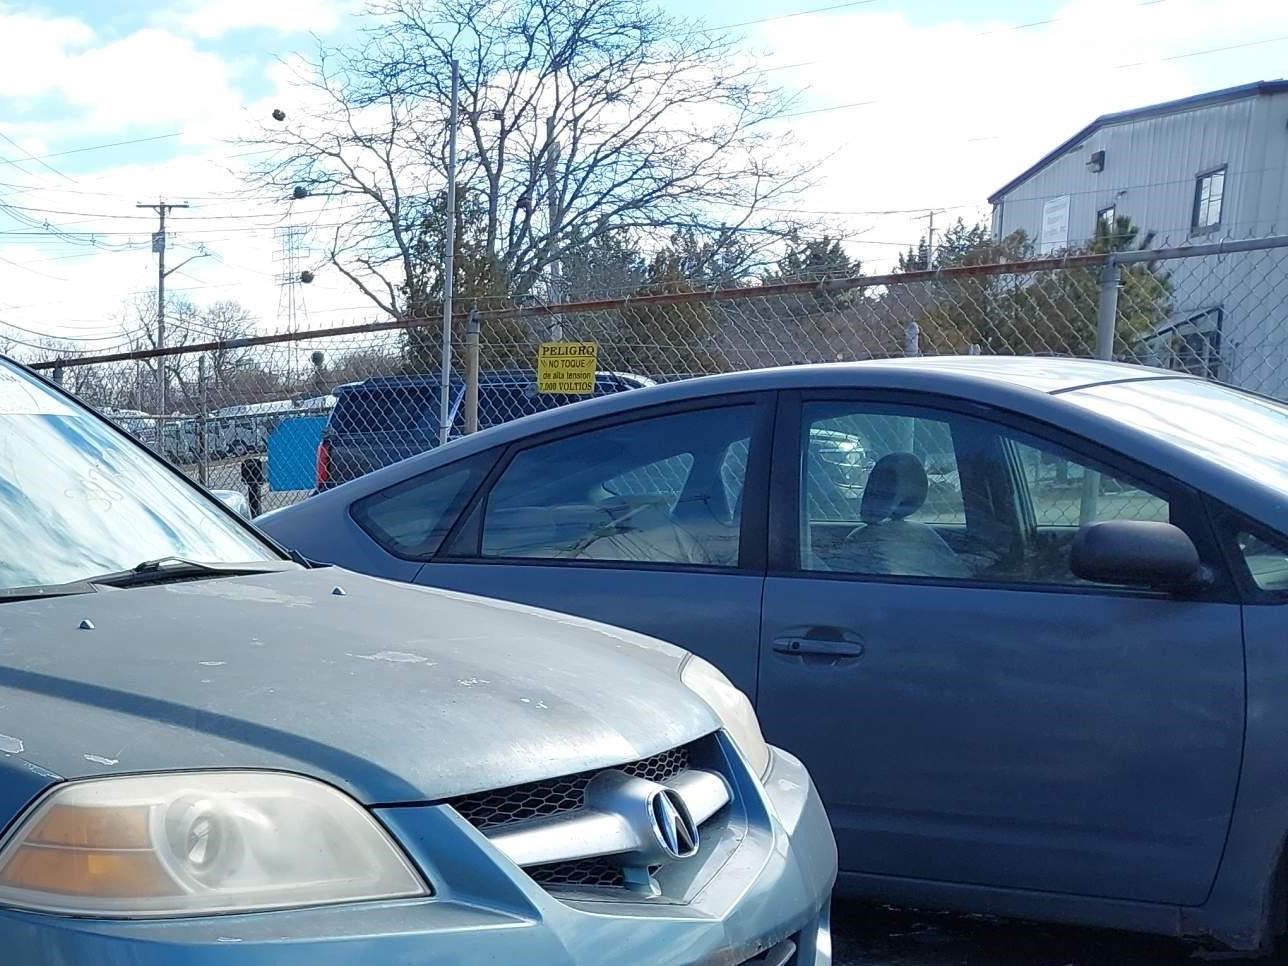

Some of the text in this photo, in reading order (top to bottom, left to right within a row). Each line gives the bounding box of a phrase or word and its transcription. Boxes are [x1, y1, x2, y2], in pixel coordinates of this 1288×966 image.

[543, 346, 594, 355] PELIGRO
[549, 360, 585, 368] NO TOQUE
[543, 371, 552, 380] de
[552, 371, 565, 380] alta
[558, 382, 592, 391] VOLTIOS
